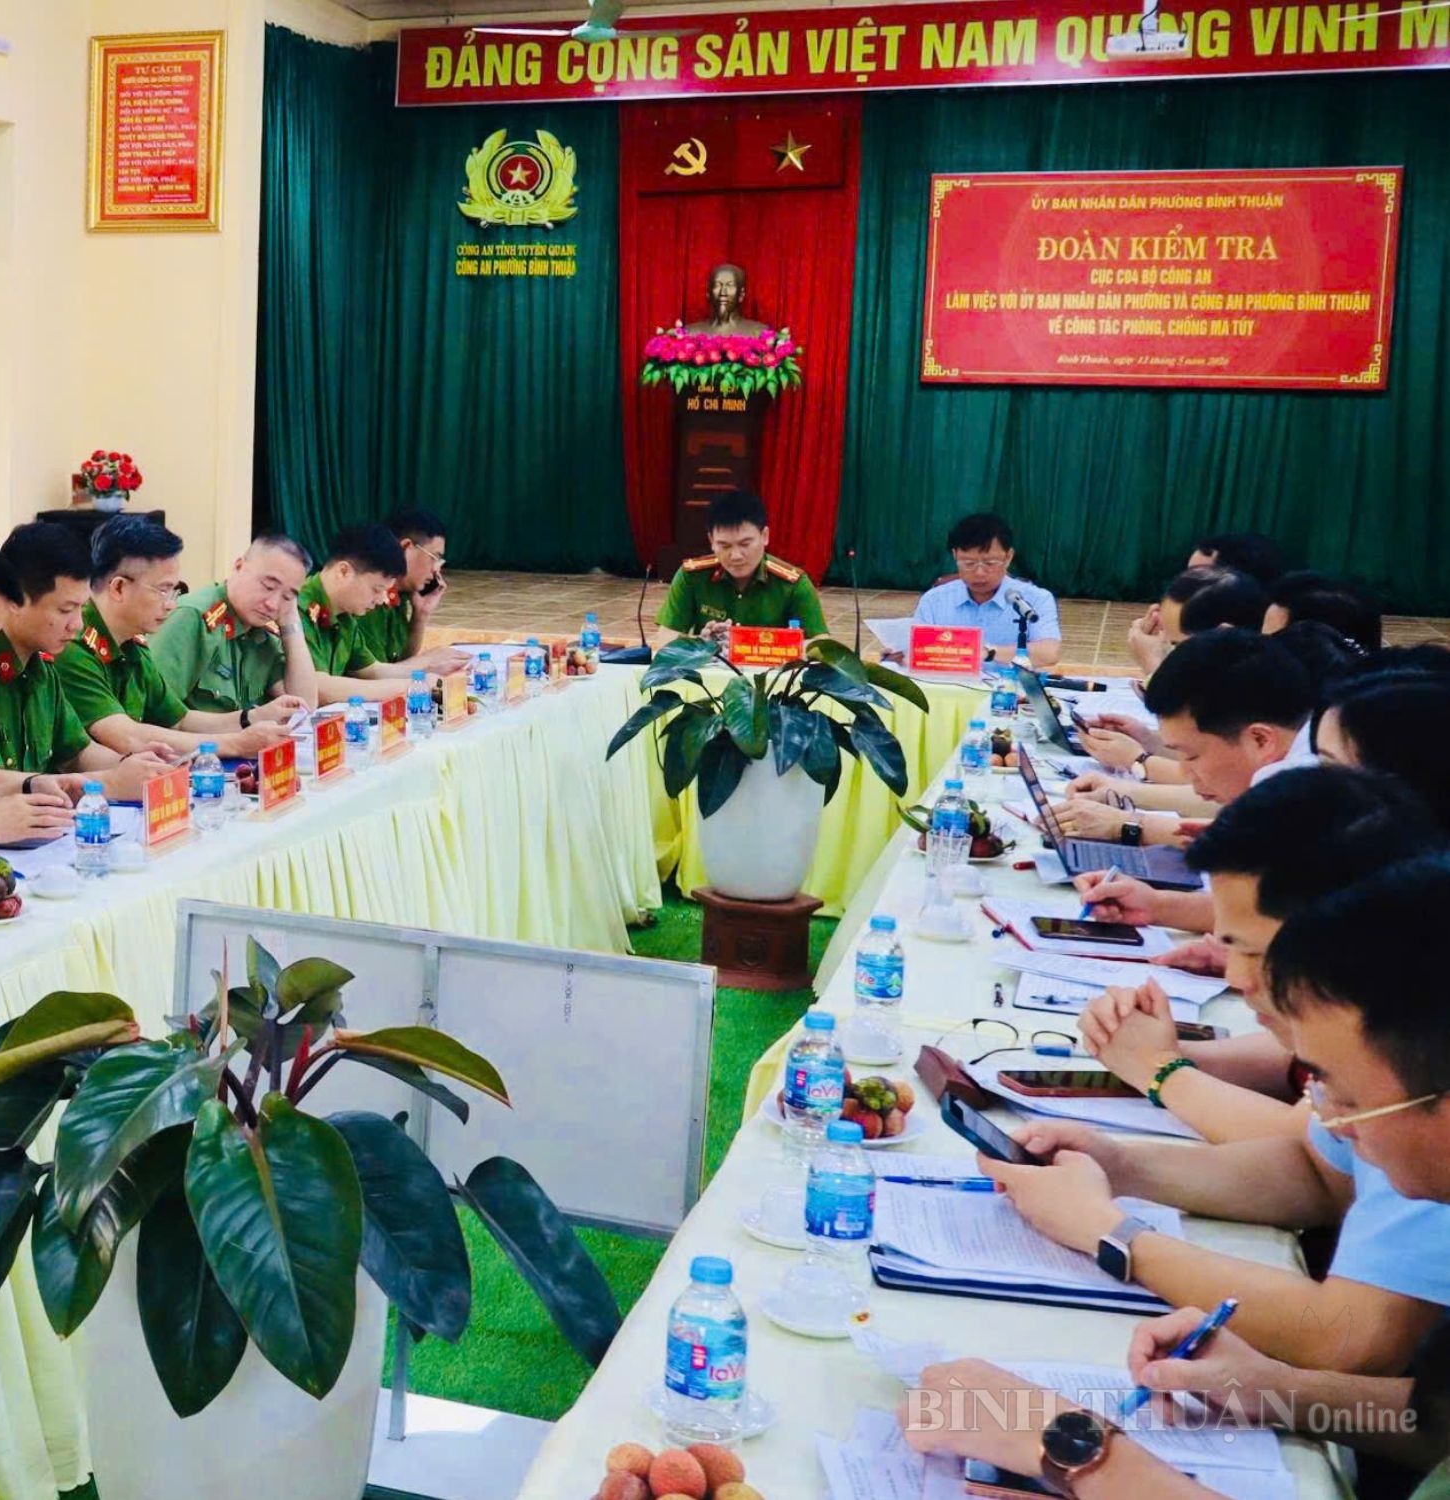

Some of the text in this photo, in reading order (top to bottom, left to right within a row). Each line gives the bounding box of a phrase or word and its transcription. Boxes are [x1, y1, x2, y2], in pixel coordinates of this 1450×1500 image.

[425, 30, 542, 89] ĐẢNG
[693, 18, 790, 79] SẢN
[805, 17, 906, 82] VIỆT
[920, 19, 1038, 69] NAM
[1055, 9, 1232, 69] QUG
[1250, 3, 1380, 56] VINH
[1051, 198, 1078, 210] BAN
[1080, 194, 1116, 209] NHÂN
[1120, 194, 1147, 209] DÂN
[1206, 192, 1237, 209] BÌNH
[1239, 192, 1284, 210] THUẬN
[481, 244, 494, 256] AN
[1037, 224, 1279, 261] ĐOÀN KIỂM TRA
[480, 259, 492, 276] AN
[1090, 268, 1114, 288] CỤC
[1159, 266, 1193, 285] CÔNG
[1194, 268, 1212, 285] AN
[946, 290, 971, 310] LÀM
[972, 290, 997, 312] VIỆC
[1037, 293, 1061, 310] BAN
[1063, 290, 1094, 310] NHÂN
[1097, 290, 1122, 310] DÂN
[1173, 290, 1188, 310] VÀ
[1190, 290, 1224, 310] CÔNG
[1225, 294, 1243, 310] AN
[1297, 290, 1327, 311] BÌNH
[1329, 290, 1371, 314] THUẬN
[1065, 315, 1096, 335] CÔNG
[1099, 316, 1120, 335] TÁC
[1167, 313, 1208, 336] CHỐNG
[1210, 319, 1230, 336] MA
[1232, 315, 1255, 336] TÚY
[722, 398, 746, 411] MINH
